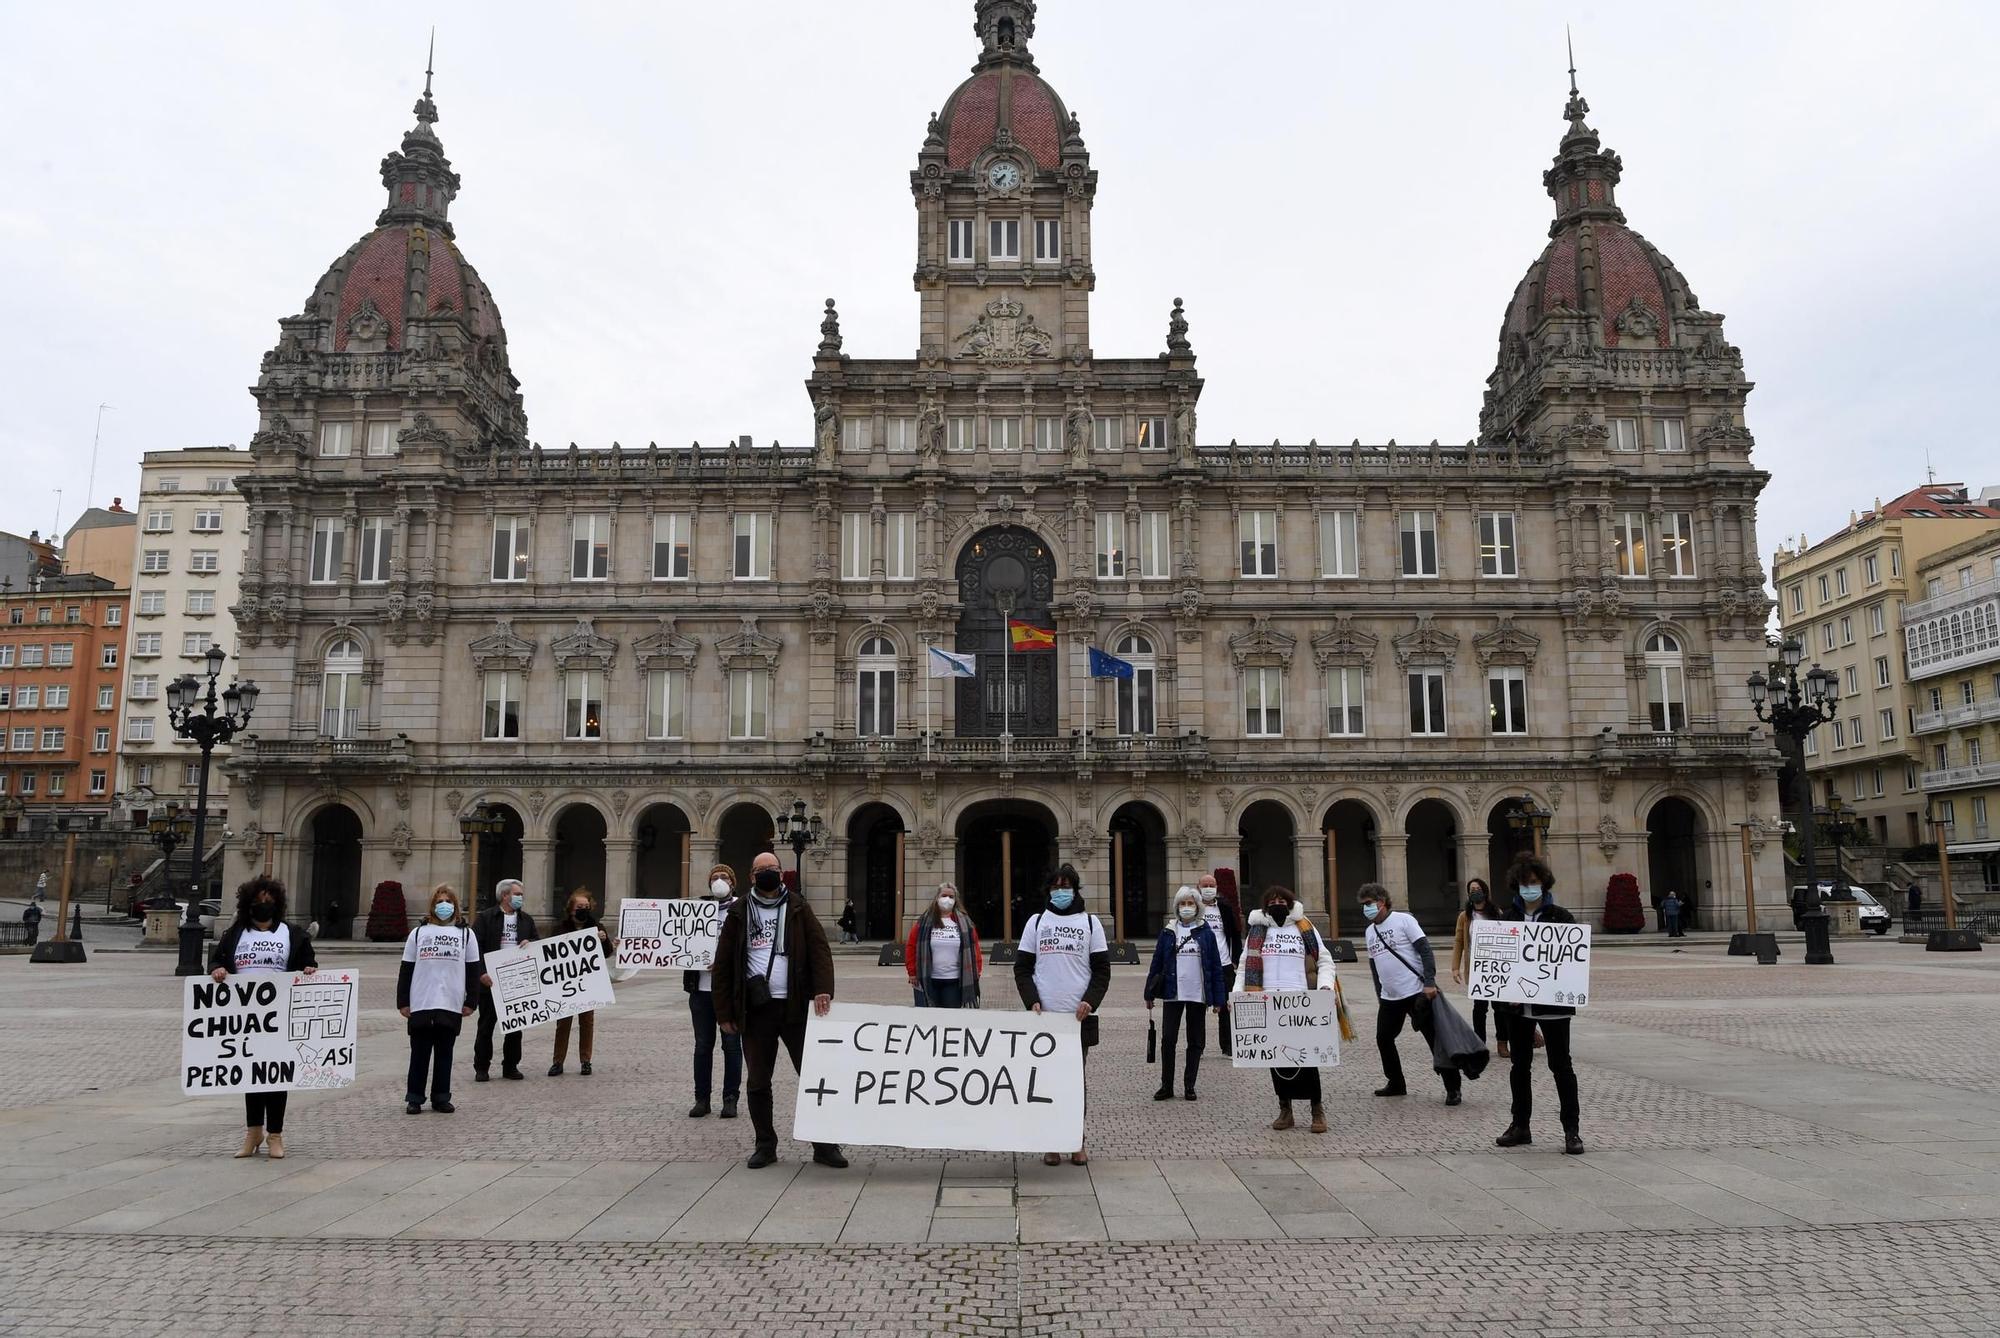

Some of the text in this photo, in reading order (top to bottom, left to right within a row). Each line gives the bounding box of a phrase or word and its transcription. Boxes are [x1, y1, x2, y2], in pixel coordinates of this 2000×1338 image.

[668, 902, 716, 918] NOVO
[662, 918, 718, 937] CHUAC
[1055, 926, 1084, 936] NOVO
[1523, 925, 1584, 944] NOVO
[435, 935, 459, 943] NOVO
[625, 939, 661, 950] PERO
[542, 935, 597, 962] NOVO
[1522, 944, 1588, 963] CHUAC
[619, 952, 653, 964] NON
[540, 954, 600, 985] CHUAC
[1474, 961, 1511, 973] PERO
[1537, 963, 1562, 980] SÍ
[300, 975, 338, 983] HOSPITAL
[1481, 974, 1510, 985] NON
[193, 981, 277, 1009] NOVO
[1471, 984, 1507, 998] ASÍ
[505, 999, 539, 1015] PERO
[188, 1011, 279, 1038] CHUAC
[501, 1015, 527, 1031] NON
[1278, 1014, 1317, 1027] CHUAC
[853, 1022, 1057, 1058] CEMENTO
[1235, 1034, 1268, 1047] PERO
[321, 1043, 354, 1066] ASÍ
[1236, 1049, 1257, 1059] NON
[187, 1061, 295, 1088] PERO NON
[855, 1065, 1053, 1105] PERSOAL
